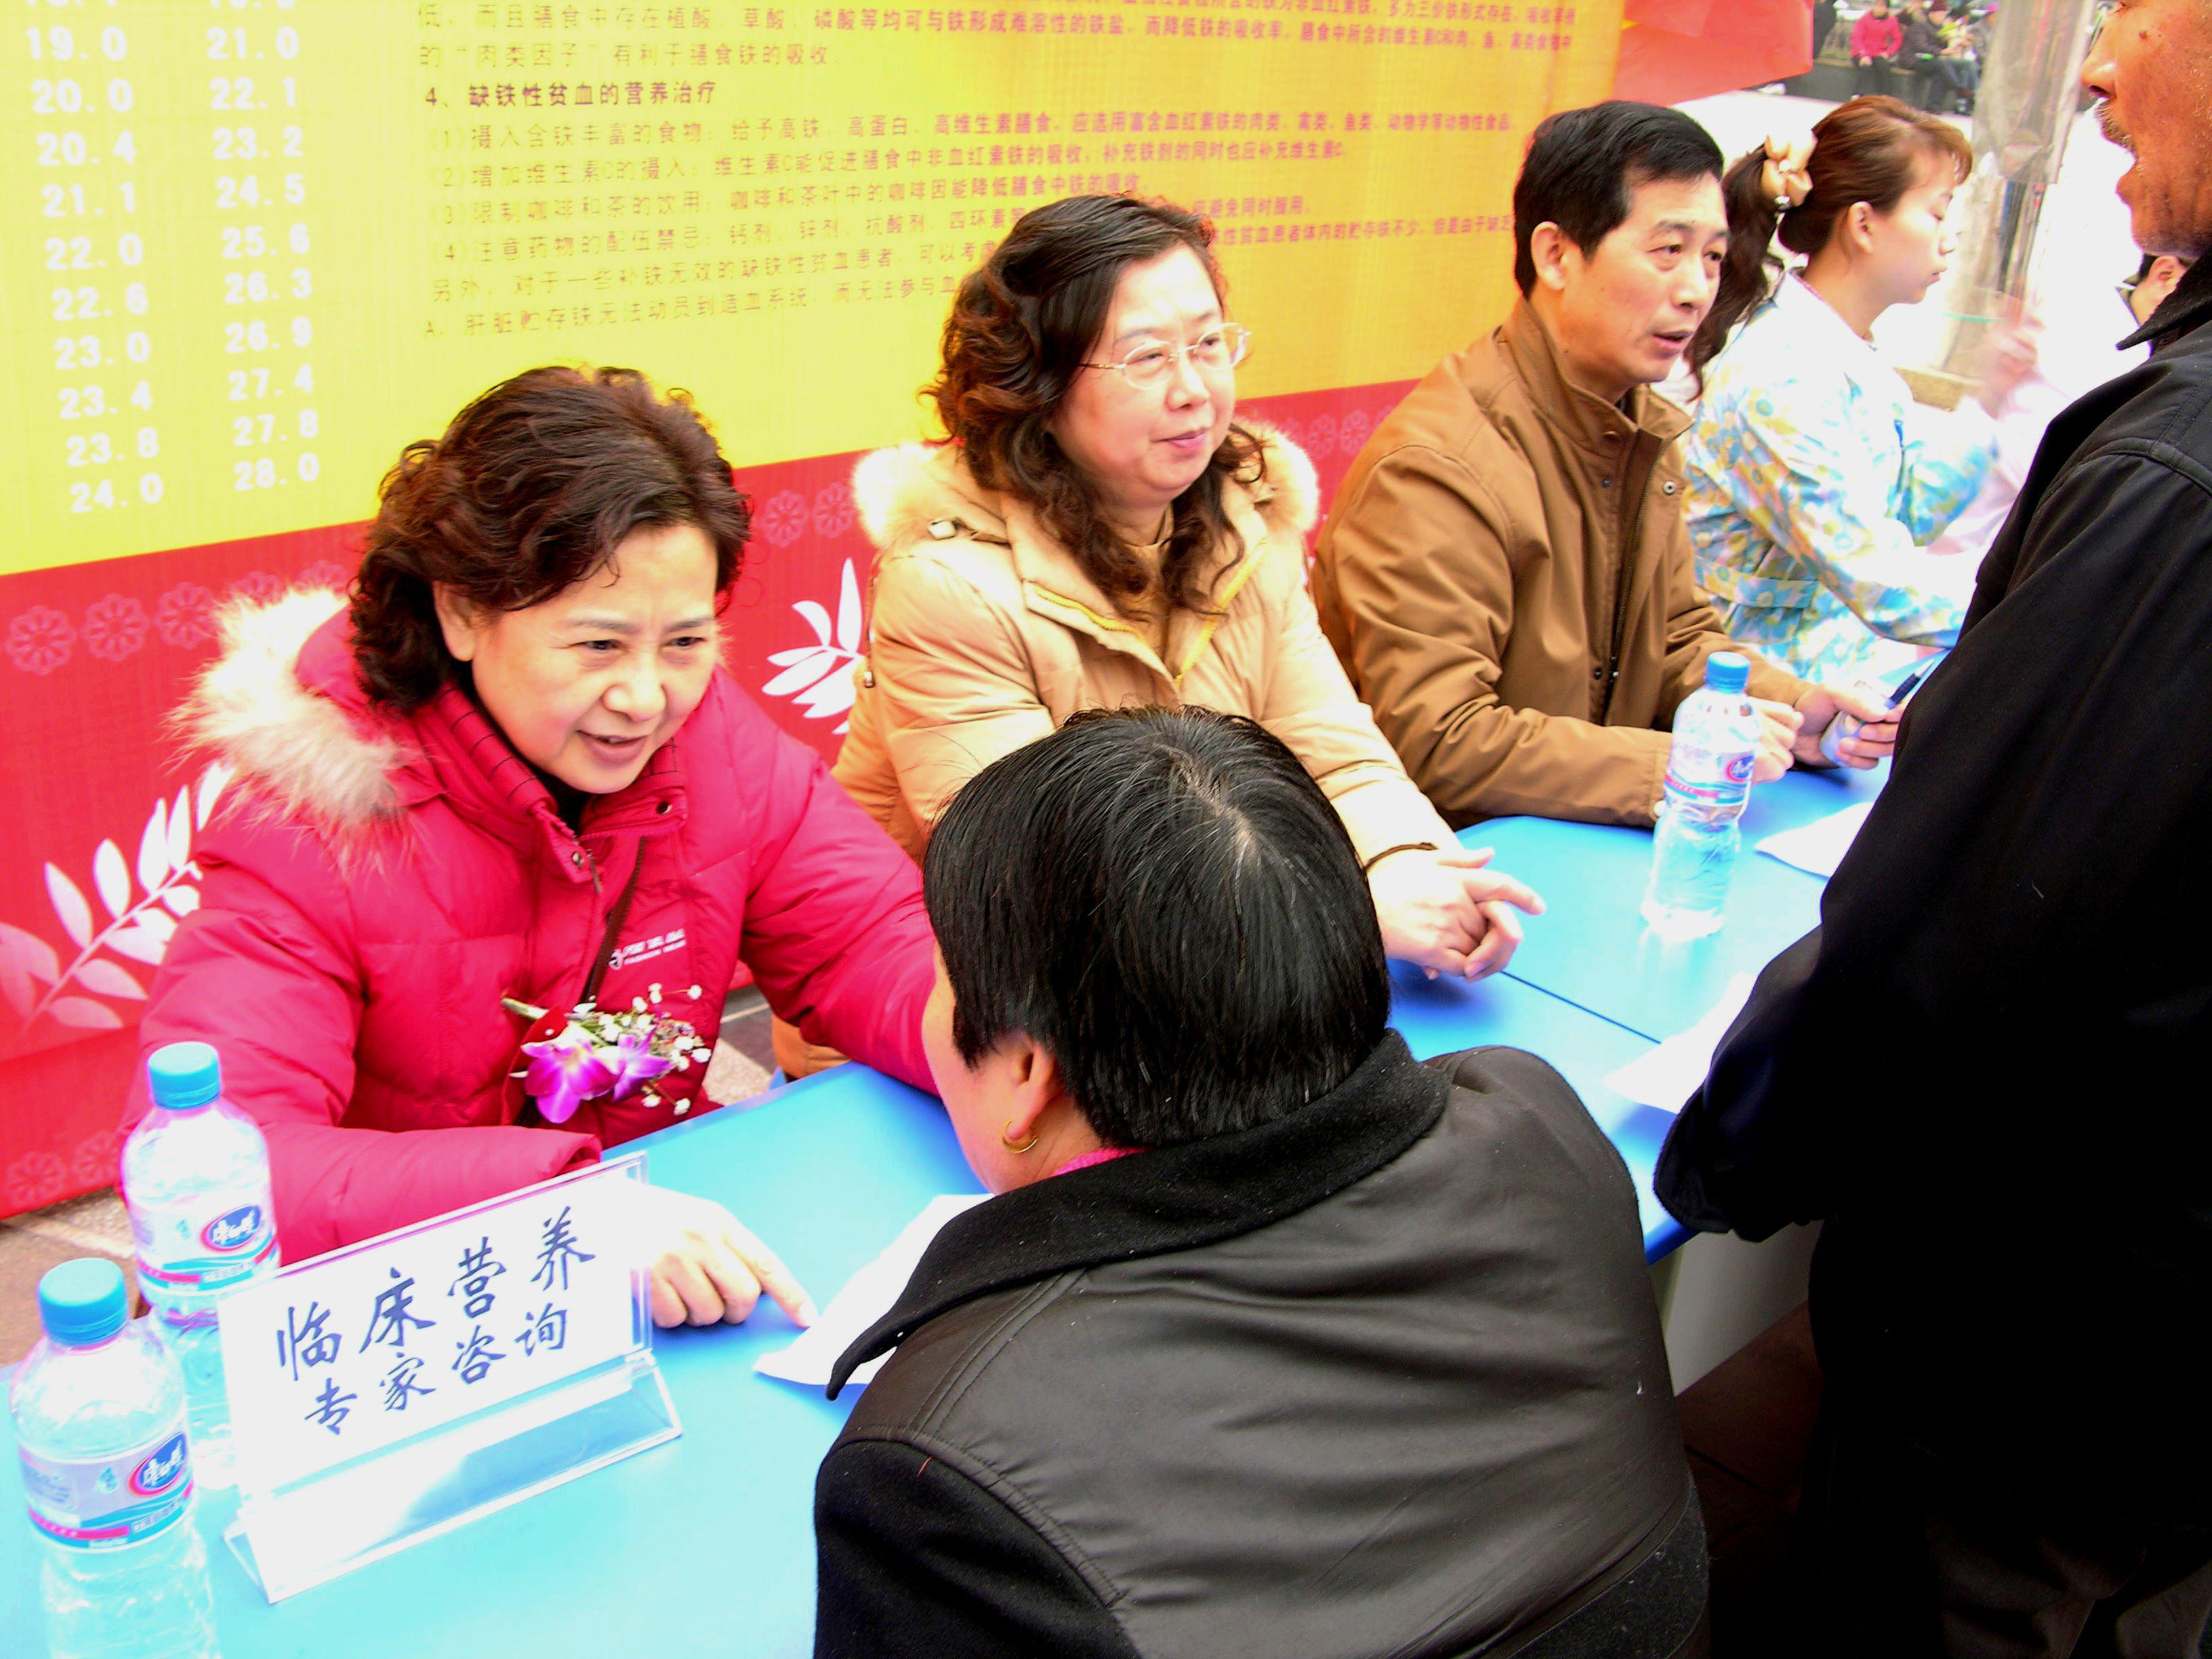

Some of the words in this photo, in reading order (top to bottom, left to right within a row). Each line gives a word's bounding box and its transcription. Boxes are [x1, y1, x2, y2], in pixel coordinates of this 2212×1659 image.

[25, 25, 127, 61] 19.0
[206, 26, 300, 60] 21.0
[31, 78, 134, 114] 20.0
[209, 76, 296, 110] 22.1
[36, 130, 137, 167] 20.4
[213, 125, 304, 160] 23.2
[42, 181, 136, 218] 21.1
[216, 173, 306, 209] 24.5
[45, 232, 143, 271] 22.0
[222, 223, 310, 259] 25.6
[52, 283, 148, 321] 22.6
[224, 268, 312, 304] 26.3
[54, 331, 150, 370] 23.0
[225, 316, 312, 354] 26.9
[58, 380, 152, 419] 23.4
[228, 364, 314, 401] 27.4
[66, 427, 159, 467] 23.8
[234, 409, 319, 446] 27.8
[70, 473, 163, 513] 24.0
[234, 453, 320, 491] 28.0
[276, 1206, 596, 1381] 临床营养
[304, 1303, 567, 1435] 专家咨询
